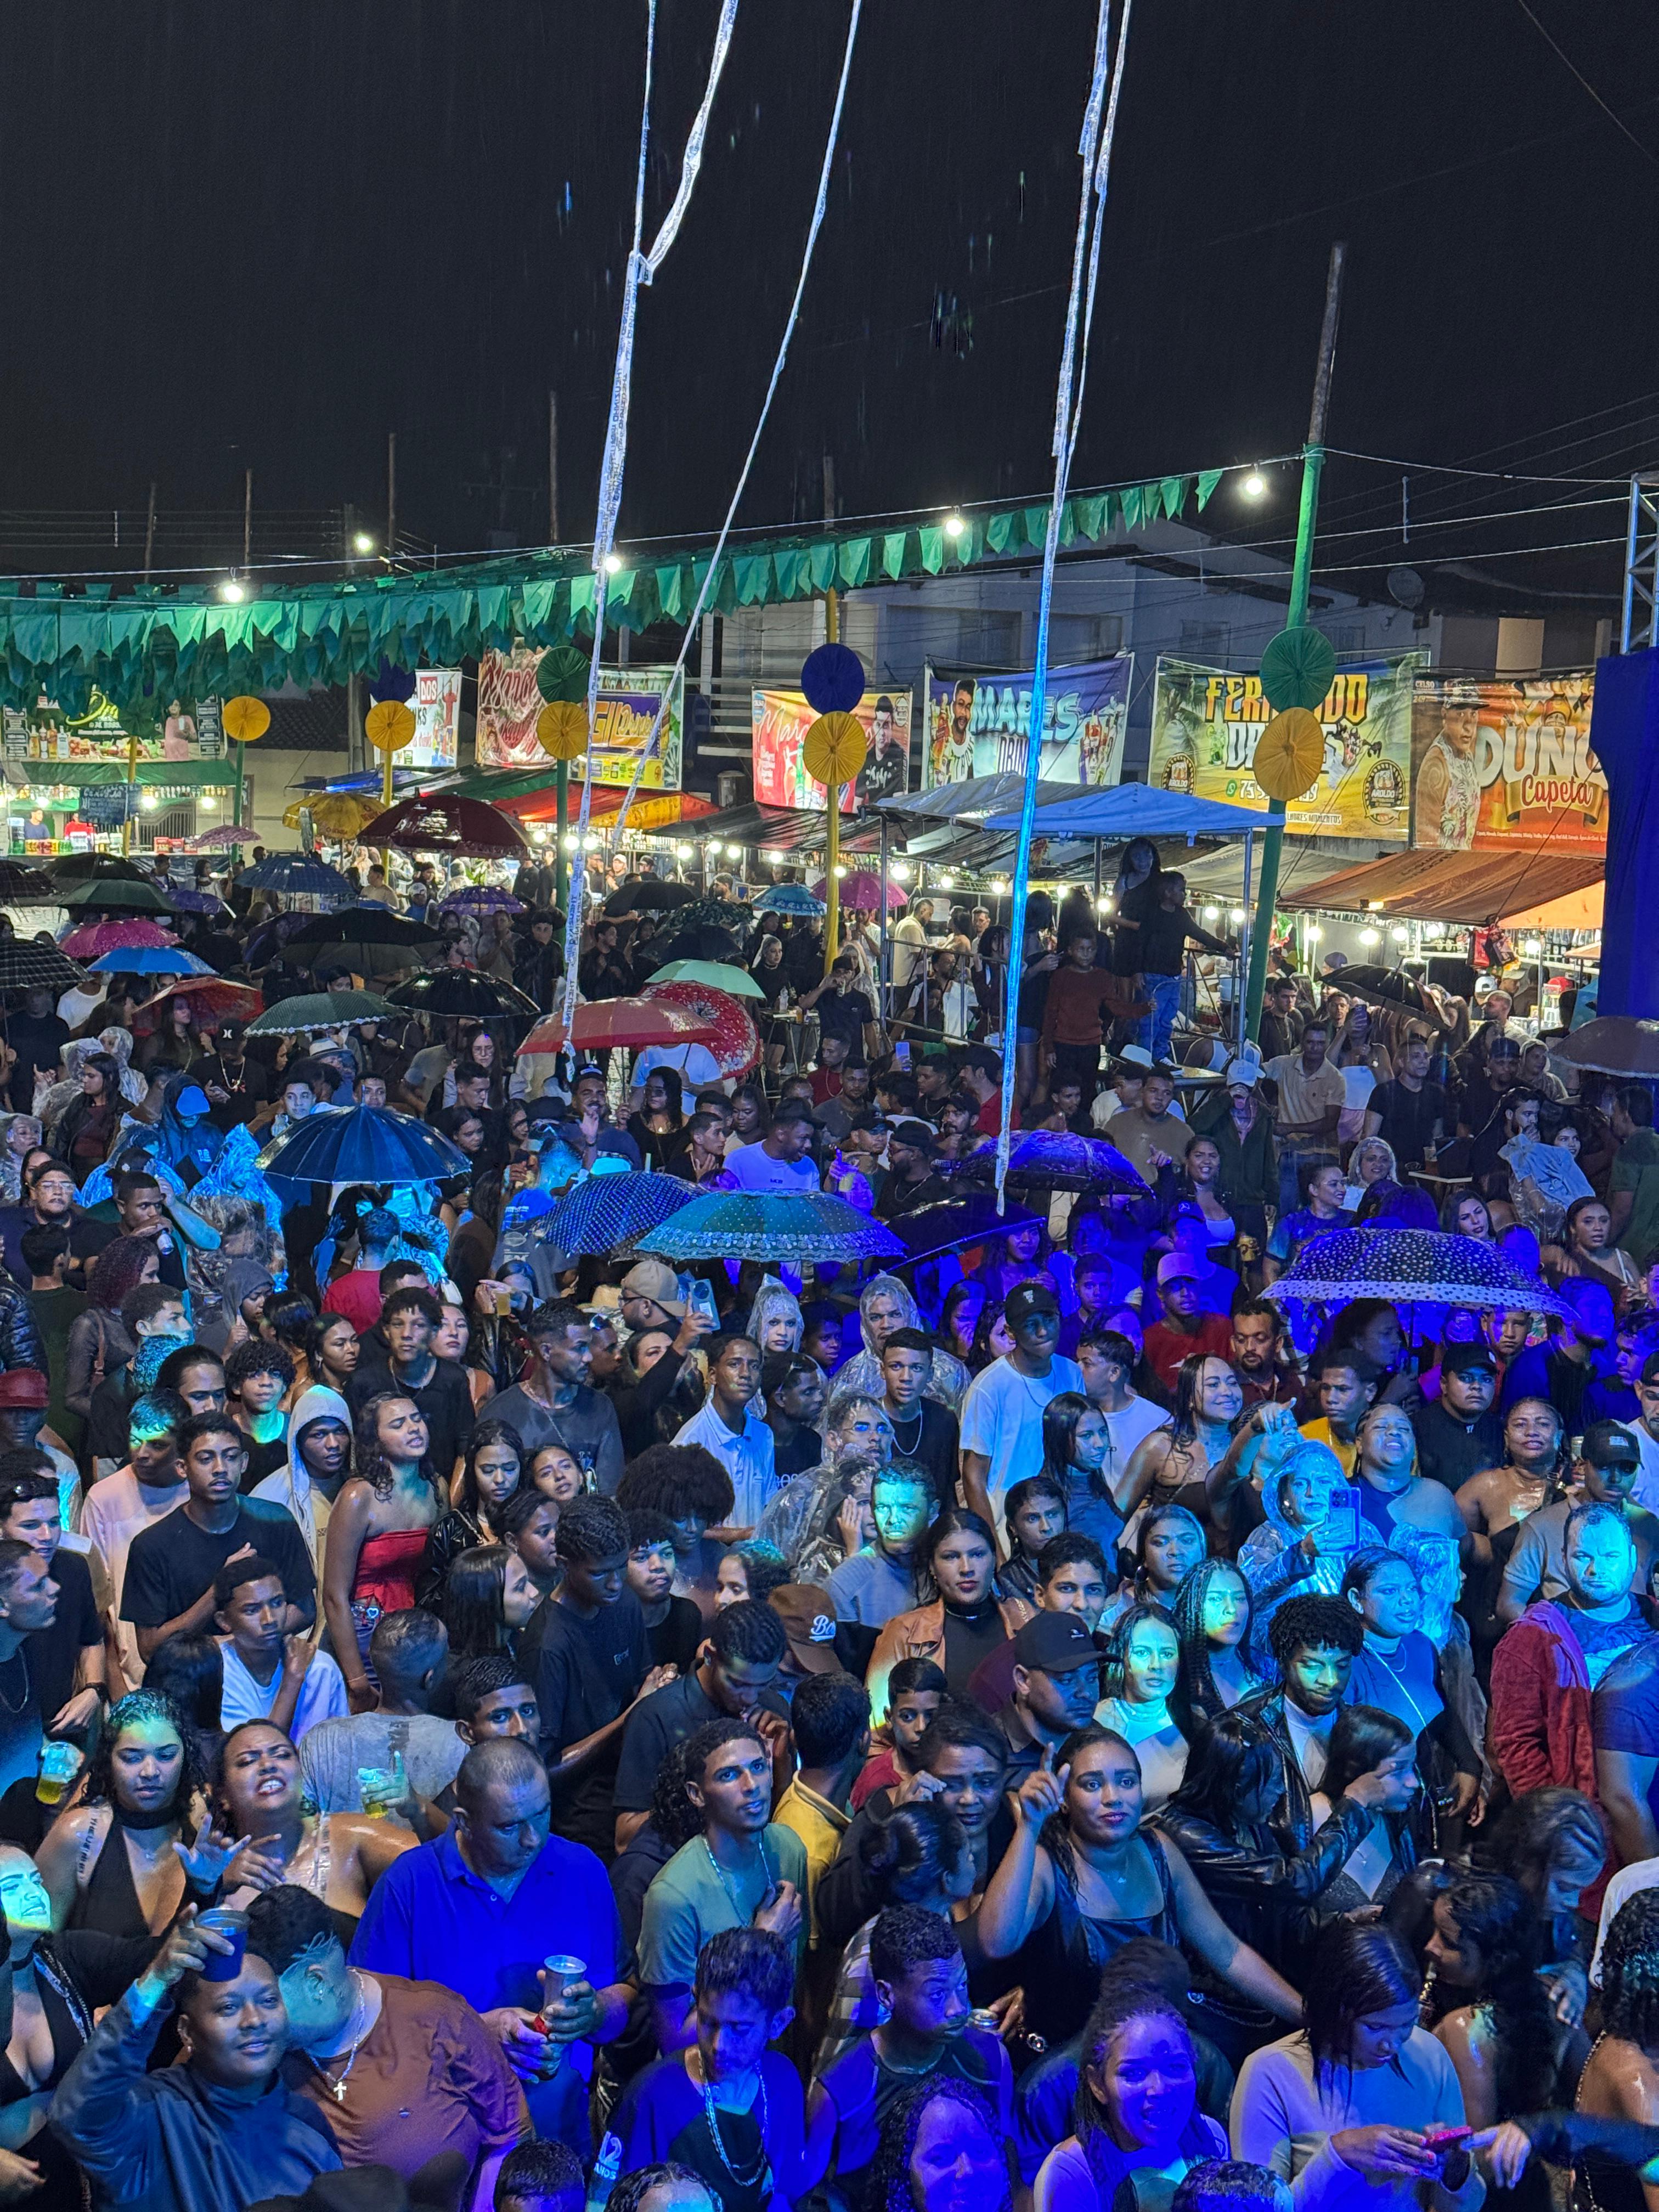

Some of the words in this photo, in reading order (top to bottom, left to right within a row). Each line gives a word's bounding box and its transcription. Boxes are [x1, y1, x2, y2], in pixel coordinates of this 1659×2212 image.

[421, 680, 437, 701] DOS
[1205, 674, 1367, 726] FERDO
[998, 736, 1042, 778] DRIN
[1372, 789, 1395, 798] AROLDO
[1521, 774, 1593, 814] Capeta
[1287, 812, 1308, 822] LHORES
